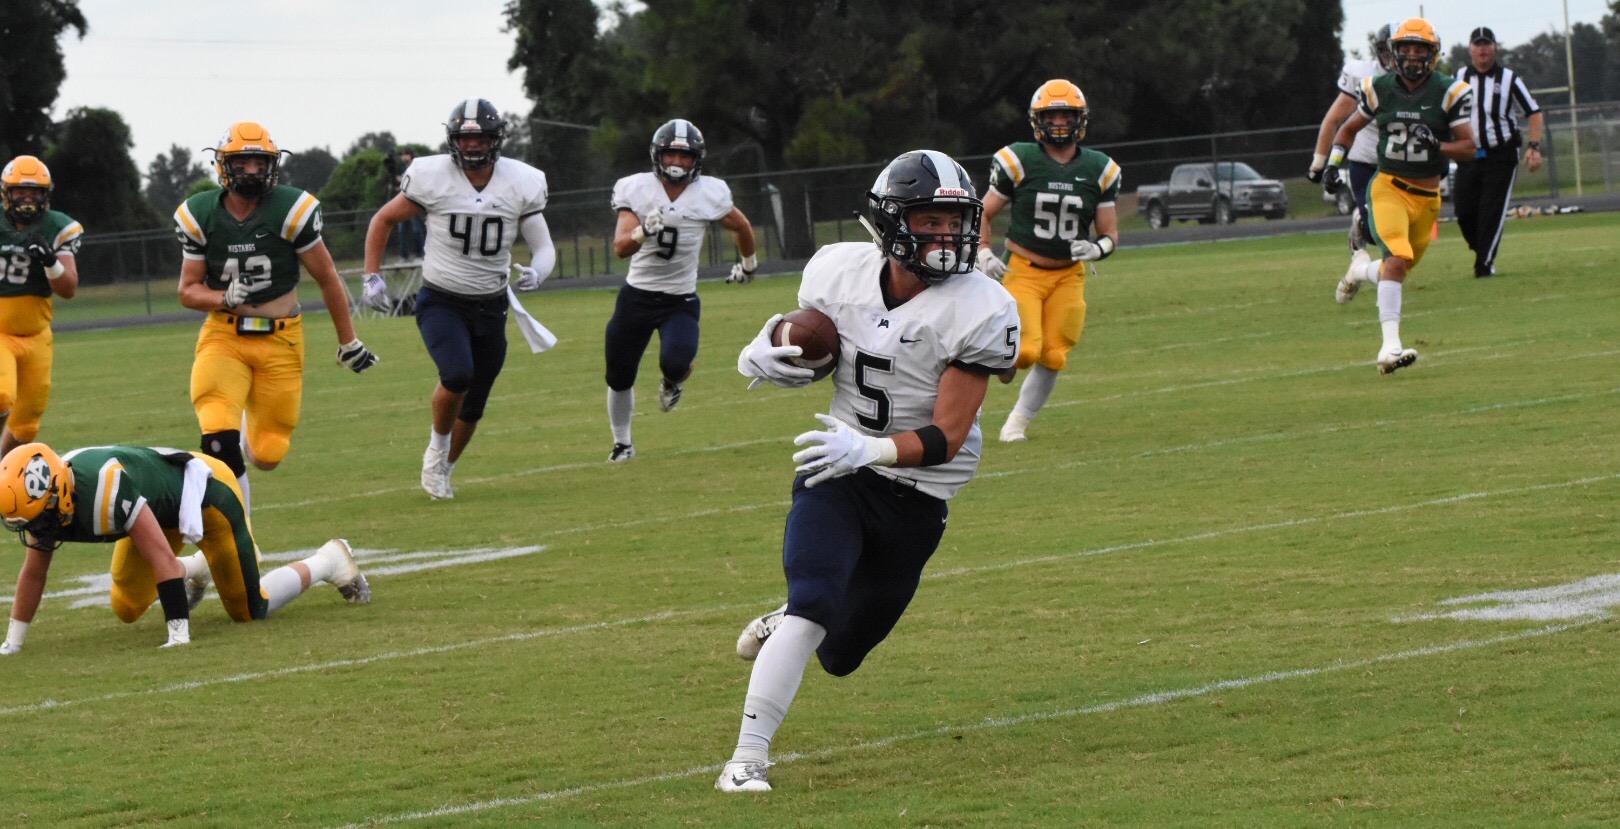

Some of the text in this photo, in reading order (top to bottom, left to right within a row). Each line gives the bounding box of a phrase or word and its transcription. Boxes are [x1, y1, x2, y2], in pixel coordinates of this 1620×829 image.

[1384, 121, 1429, 162] 22
[939, 188, 966, 196] Riddell
[1047, 181, 1074, 192] MUSTANGS
[448, 213, 504, 257] 40
[1033, 191, 1084, 241] 56
[227, 242, 256, 253] MUSTANGS
[656, 225, 679, 261] 9
[220, 254, 272, 294] 42
[1003, 325, 1018, 361] 5
[852, 346, 896, 434] 5
